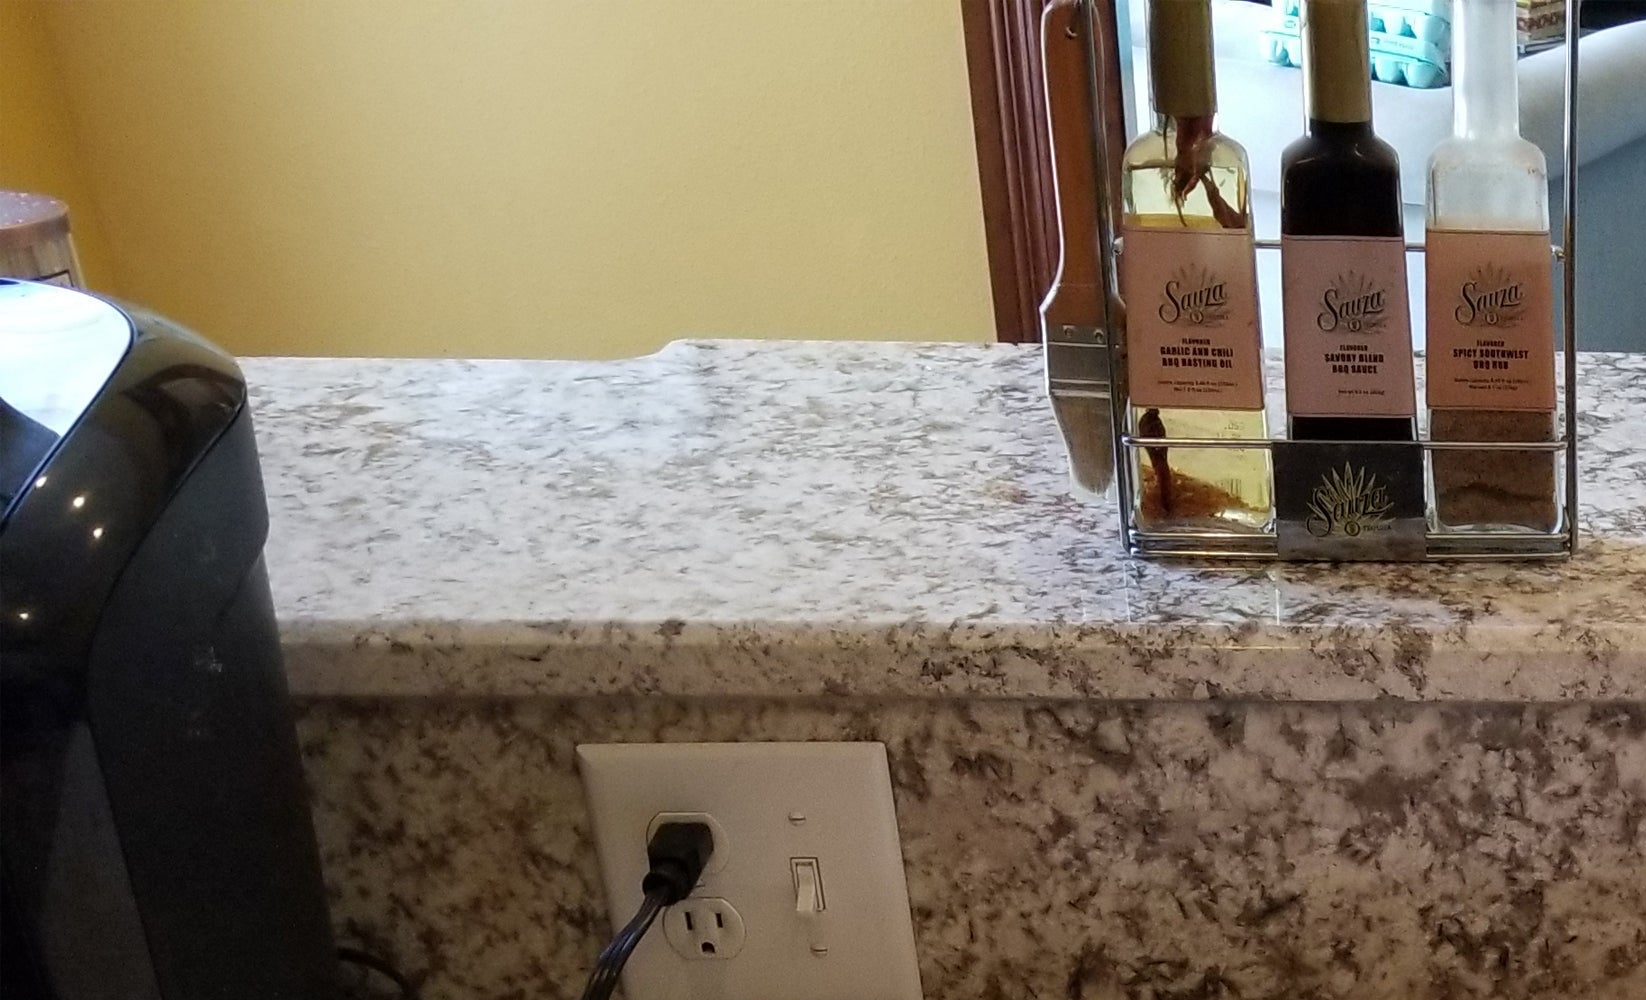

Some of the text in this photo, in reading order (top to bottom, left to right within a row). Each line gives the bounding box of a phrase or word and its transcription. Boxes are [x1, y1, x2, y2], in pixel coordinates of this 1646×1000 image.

[1158, 281, 1228, 324] Sauza
[1454, 282, 1524, 325] Sauza
[1316, 288, 1386, 332] Sauza
[1160, 346, 1234, 358] GARLIC AND CHILI
[1324, 353, 1385, 363] SAVORY BLEND
[1453, 348, 1529, 360] SPICY SOUTHWEST
[1162, 357, 1233, 369] BBQ BASTING OIL
[1332, 364, 1378, 374] BBQ SAUCE
[1306, 485, 1394, 538] Sauza
